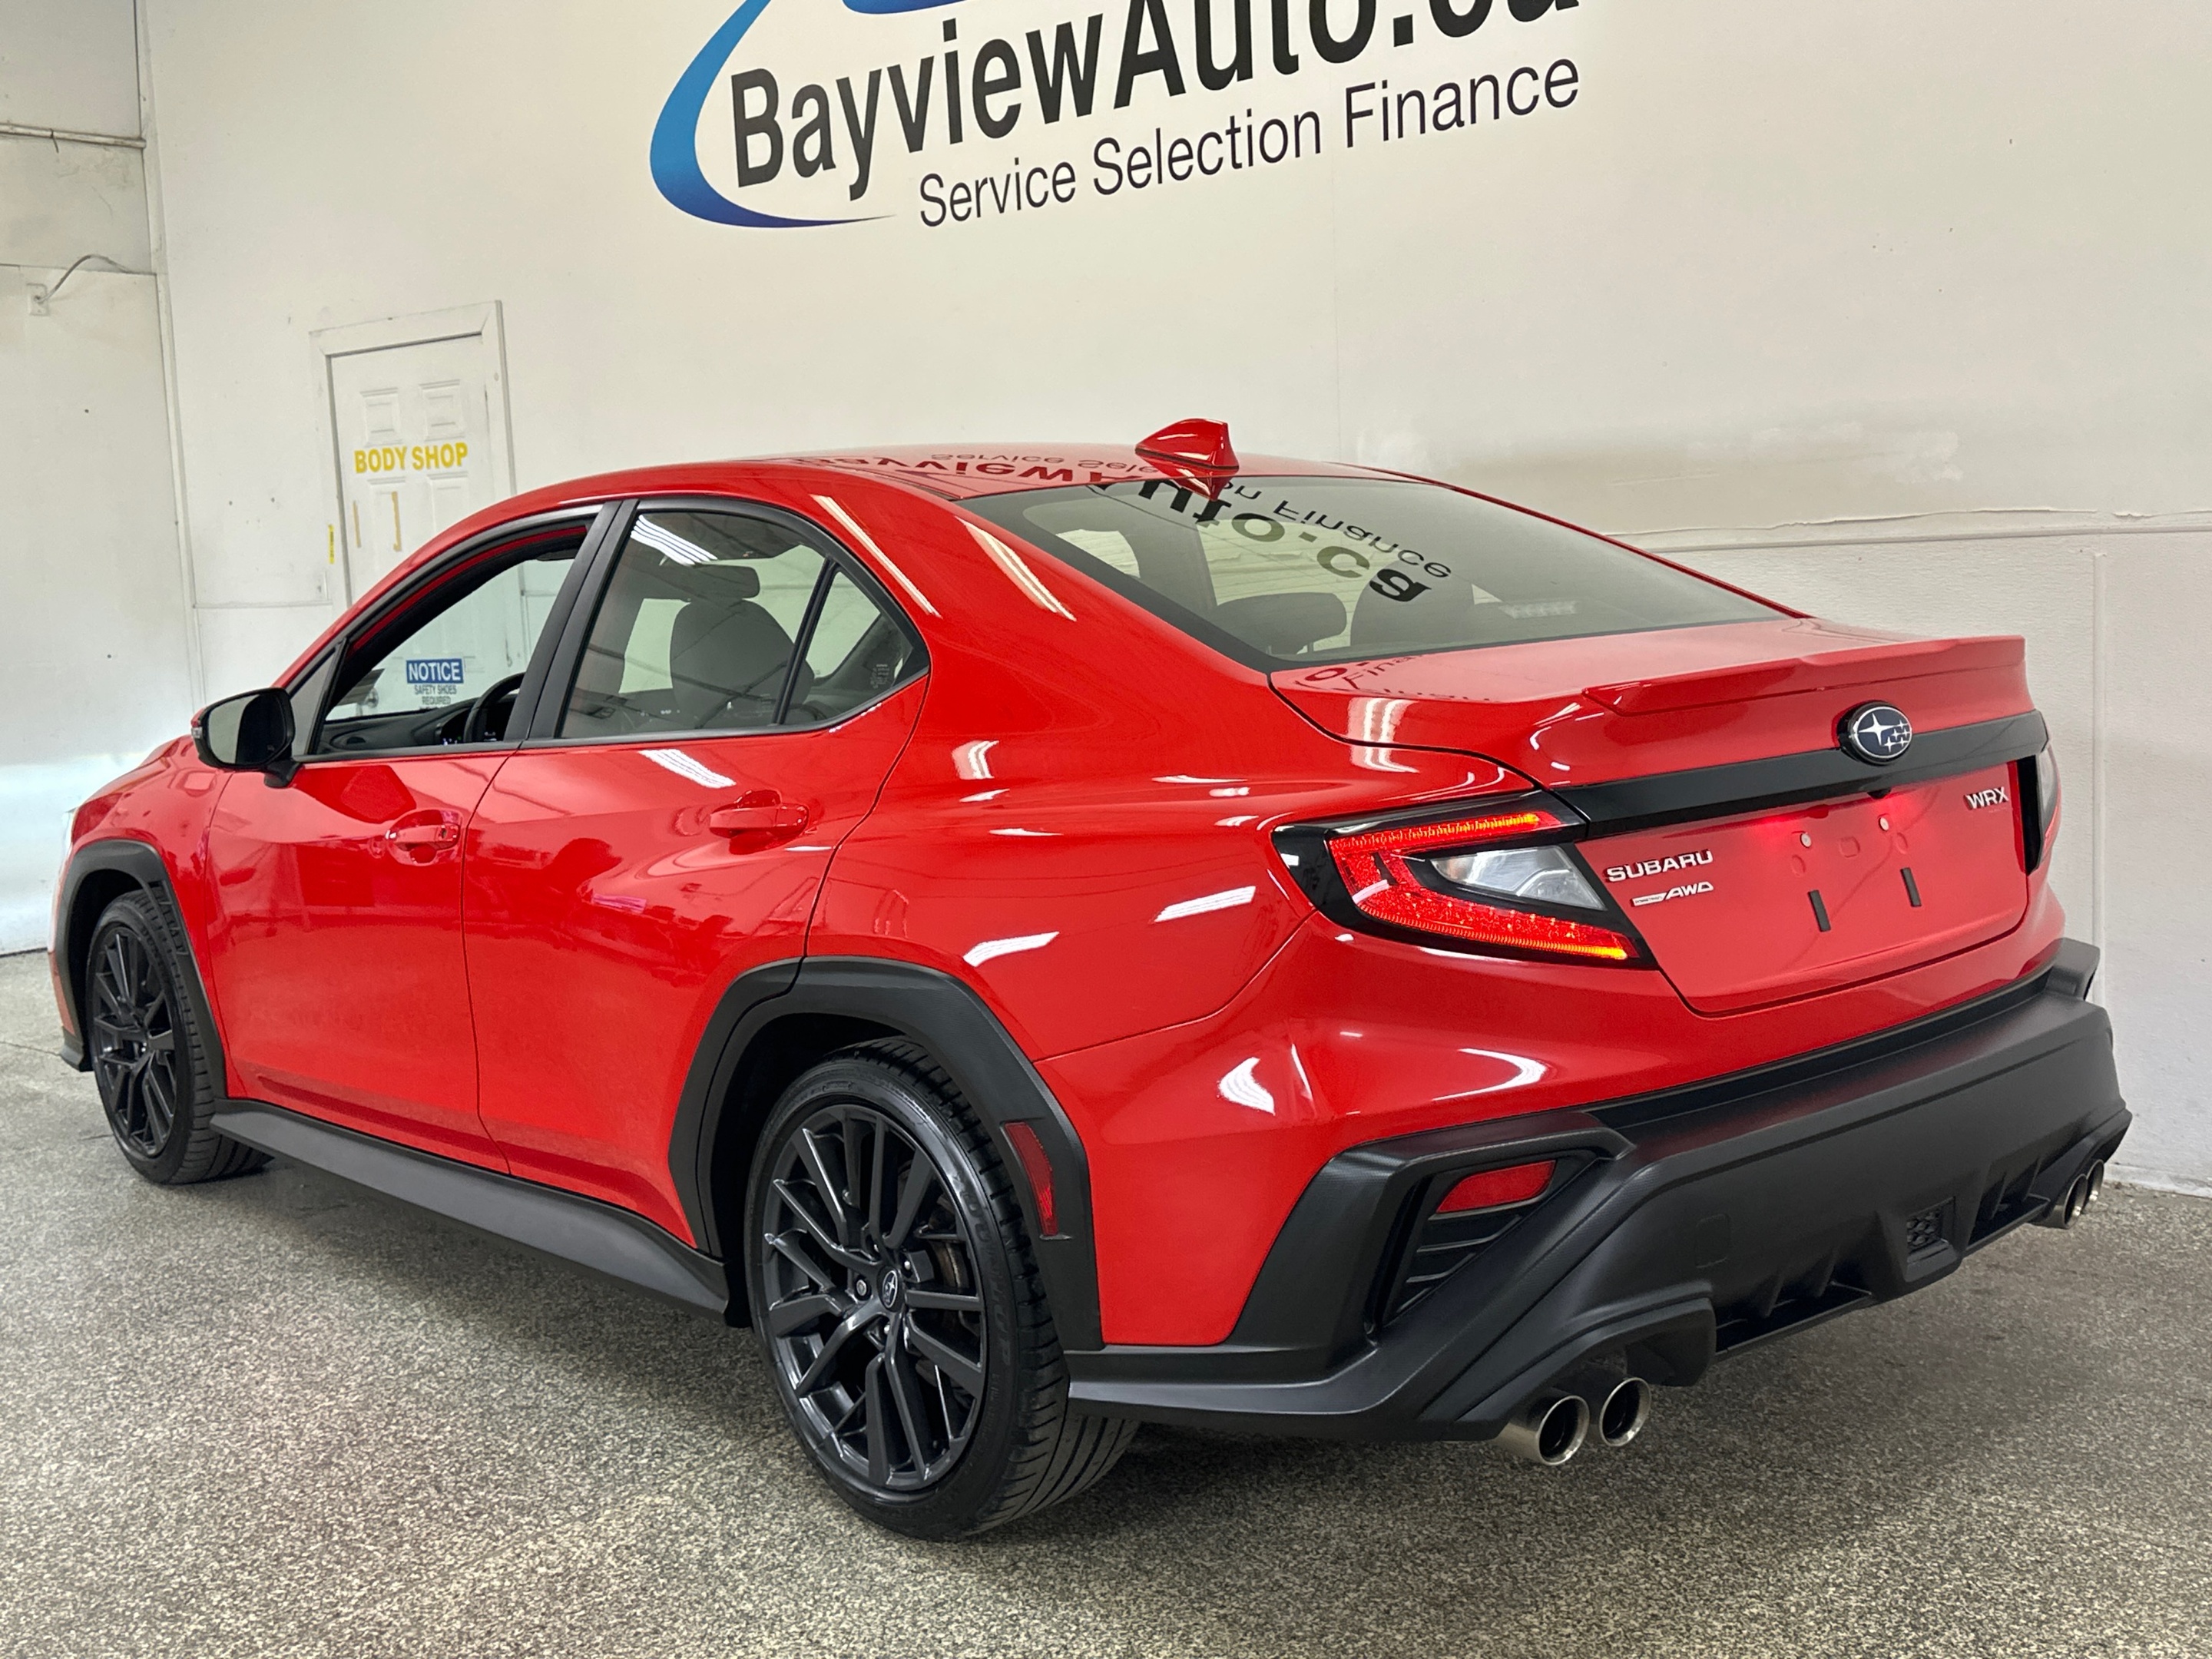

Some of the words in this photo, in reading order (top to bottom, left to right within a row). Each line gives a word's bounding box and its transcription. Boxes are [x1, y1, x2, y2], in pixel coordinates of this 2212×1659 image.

[731, 0, 1580, 201] BayviewAuto.
[920, 157, 1076, 227] Service
[1093, 108, 1321, 195] Selection
[1345, 58, 1579, 148] Finance
[354, 446, 407, 474] BODY
[412, 442, 468, 470] SHOP
[408, 661, 461, 681] NOTICE
[1965, 786, 2008, 809] WRX
[1605, 849, 1714, 882] SUBARU
[1666, 881, 1714, 899] AWD
